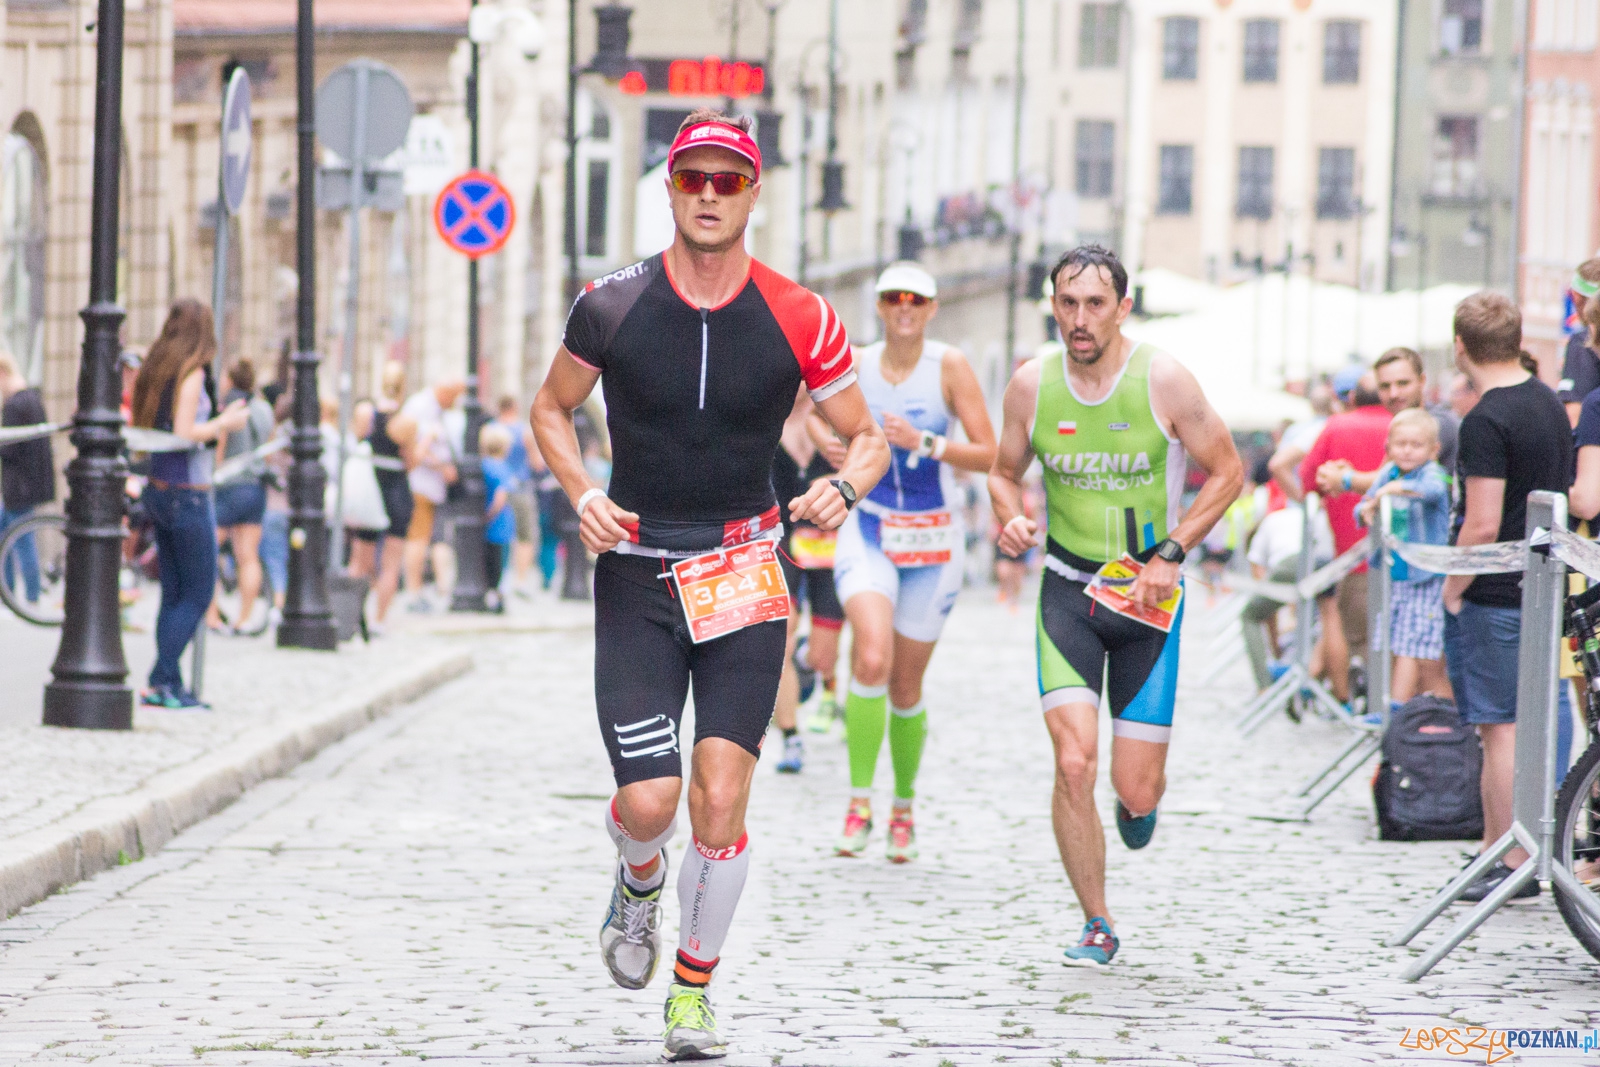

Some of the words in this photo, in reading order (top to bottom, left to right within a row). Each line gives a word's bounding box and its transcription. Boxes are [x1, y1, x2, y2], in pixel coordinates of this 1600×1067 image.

[891, 531, 945, 545] 4357
[694, 569, 772, 606] 3641
[691, 860, 711, 935] COMPRESSPORT
